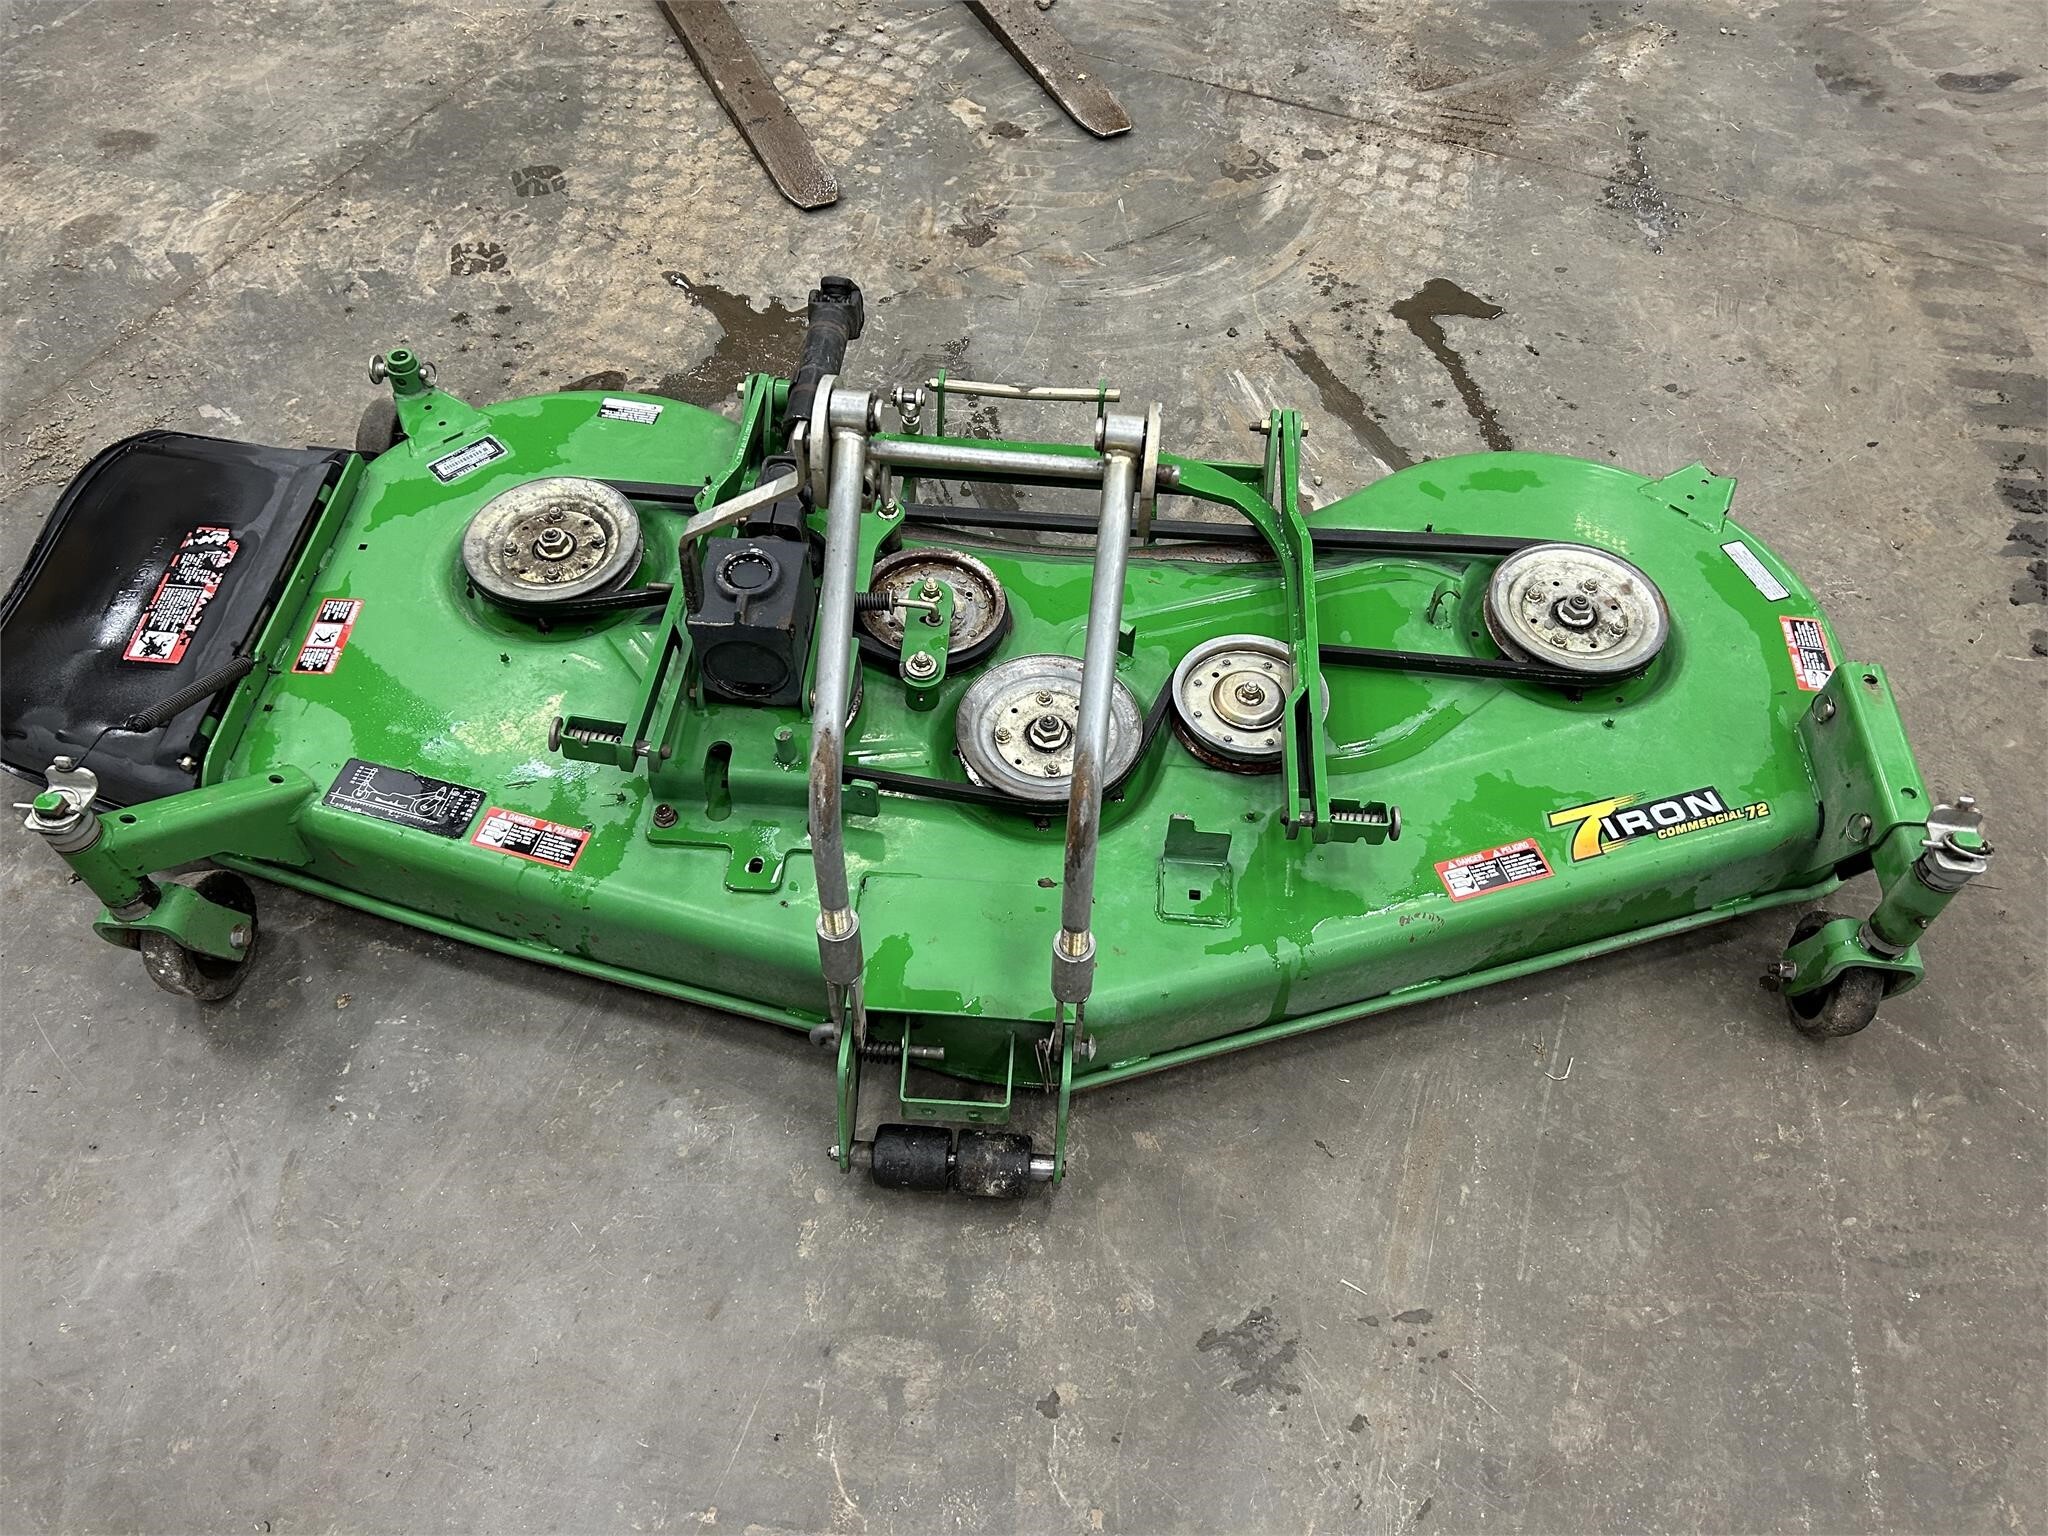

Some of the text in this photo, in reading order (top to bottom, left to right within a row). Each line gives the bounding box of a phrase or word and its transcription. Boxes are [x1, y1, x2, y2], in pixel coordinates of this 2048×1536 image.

[132, 558, 156, 584] NOT
[1602, 791, 1723, 838] IRON
[1656, 802, 1769, 839] COMMERCIAL 72
